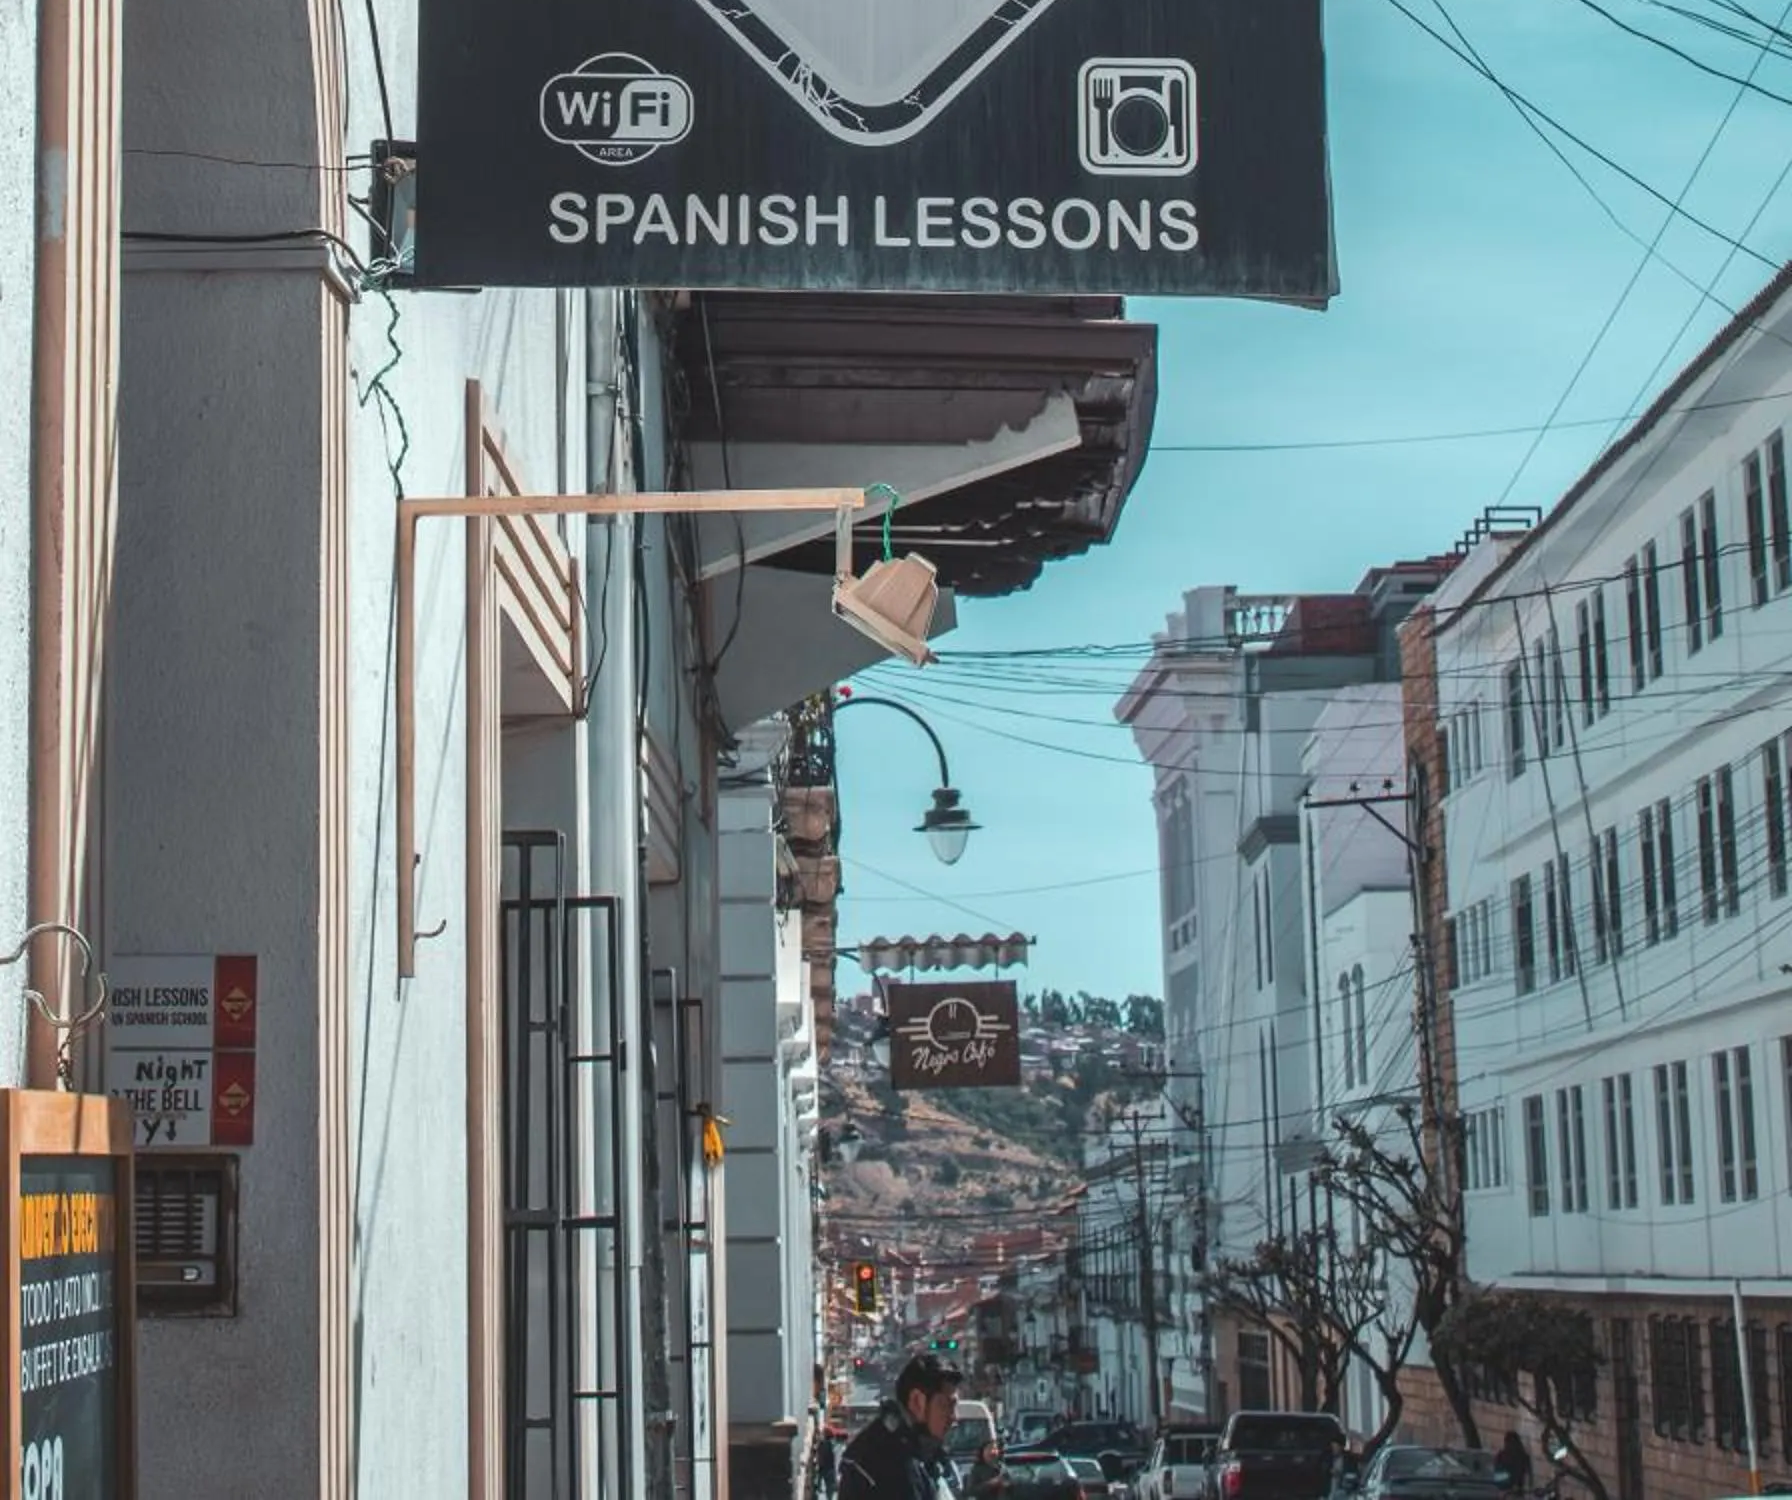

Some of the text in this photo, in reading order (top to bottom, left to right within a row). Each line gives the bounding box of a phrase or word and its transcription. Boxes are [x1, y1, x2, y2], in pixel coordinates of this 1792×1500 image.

[599, 147, 633, 157] AREA
[548, 192, 1200, 251] SPANISH LESSONS
[145, 987, 208, 1007] LESSONS
[162, 1089, 203, 1111] BELL
[22, 1281, 52, 1326] TODO
[22, 1343, 57, 1392] BUFFET
[60, 1340, 71, 1381] DE
[20, 1435, 63, 1500] OPA
